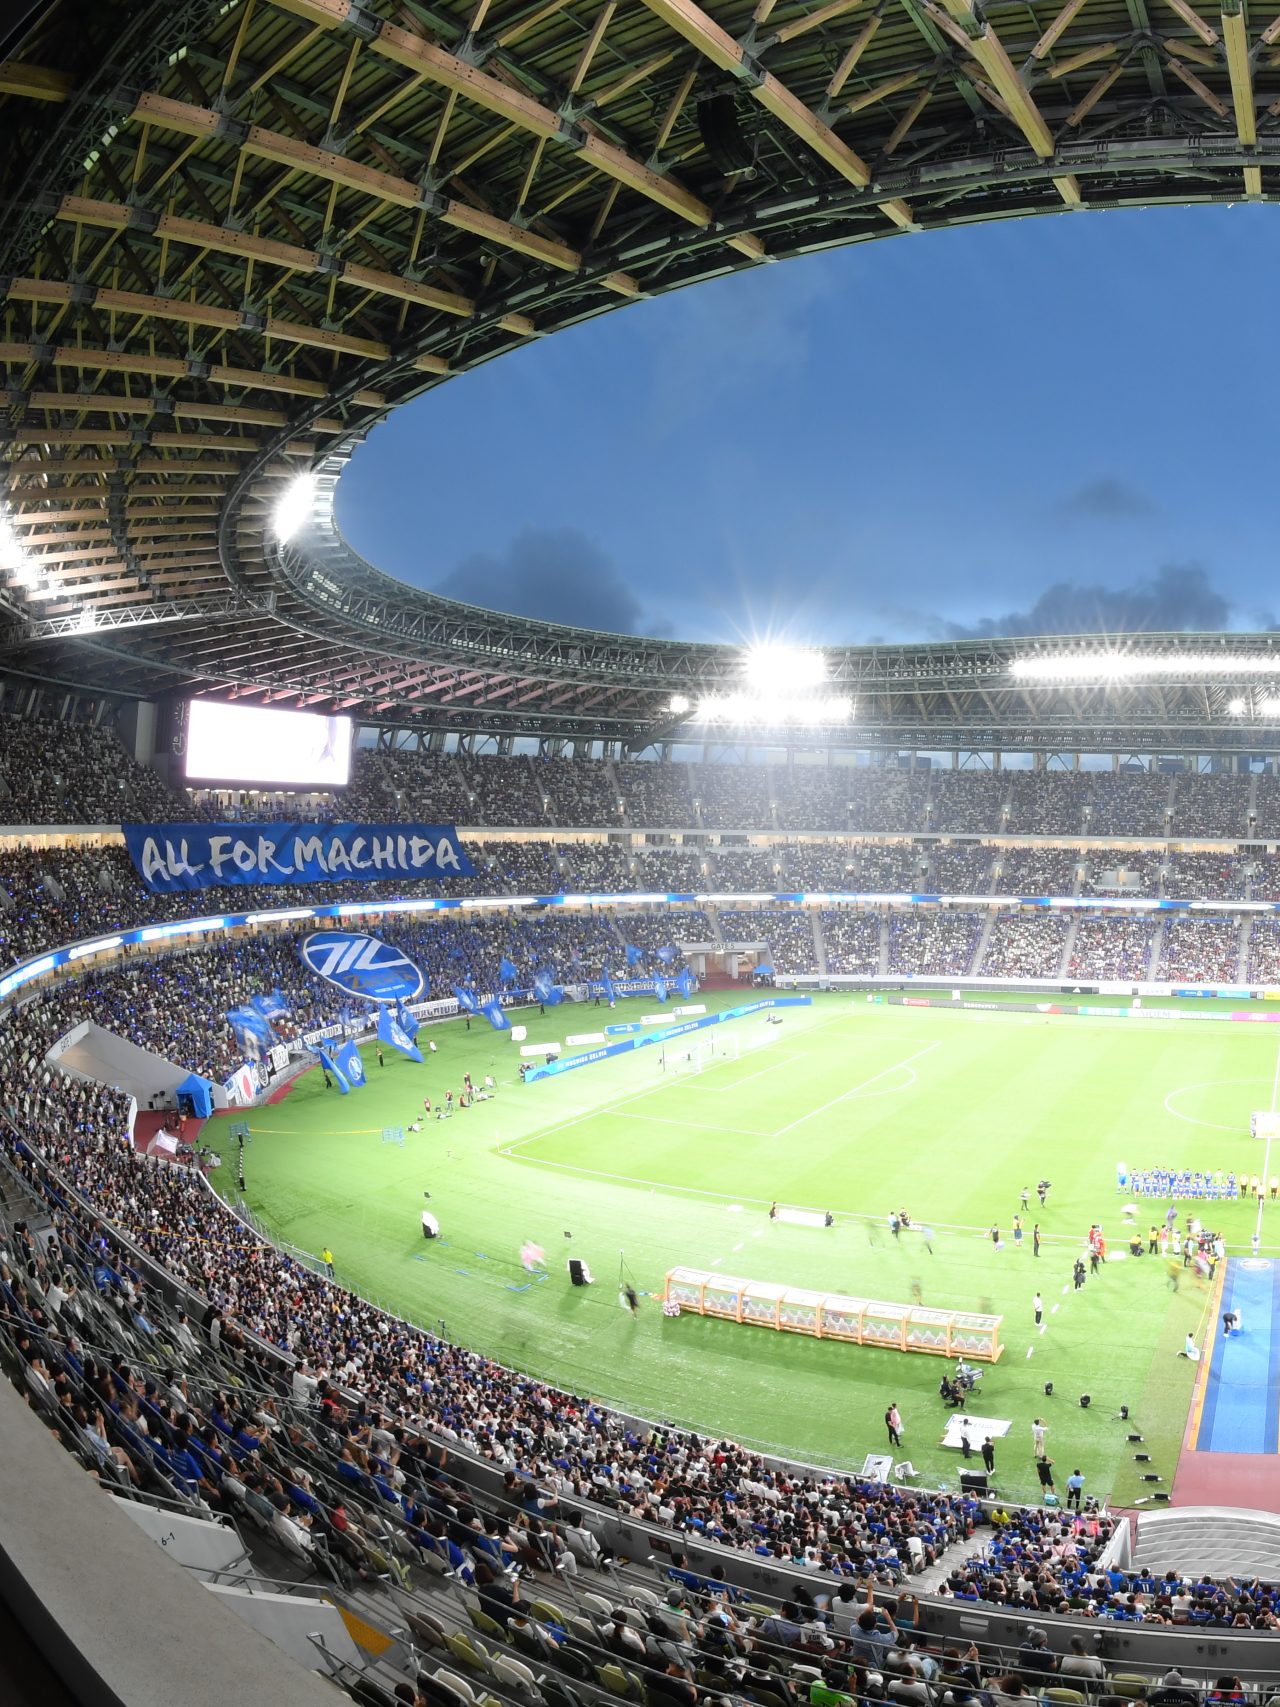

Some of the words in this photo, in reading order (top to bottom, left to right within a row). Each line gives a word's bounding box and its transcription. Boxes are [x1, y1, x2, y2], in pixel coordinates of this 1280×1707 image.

[142, 837, 205, 882] ALL
[208, 836, 293, 877] FOR
[294, 836, 461, 873] MACHIDA
[1165, 1586, 1171, 1596] 9
